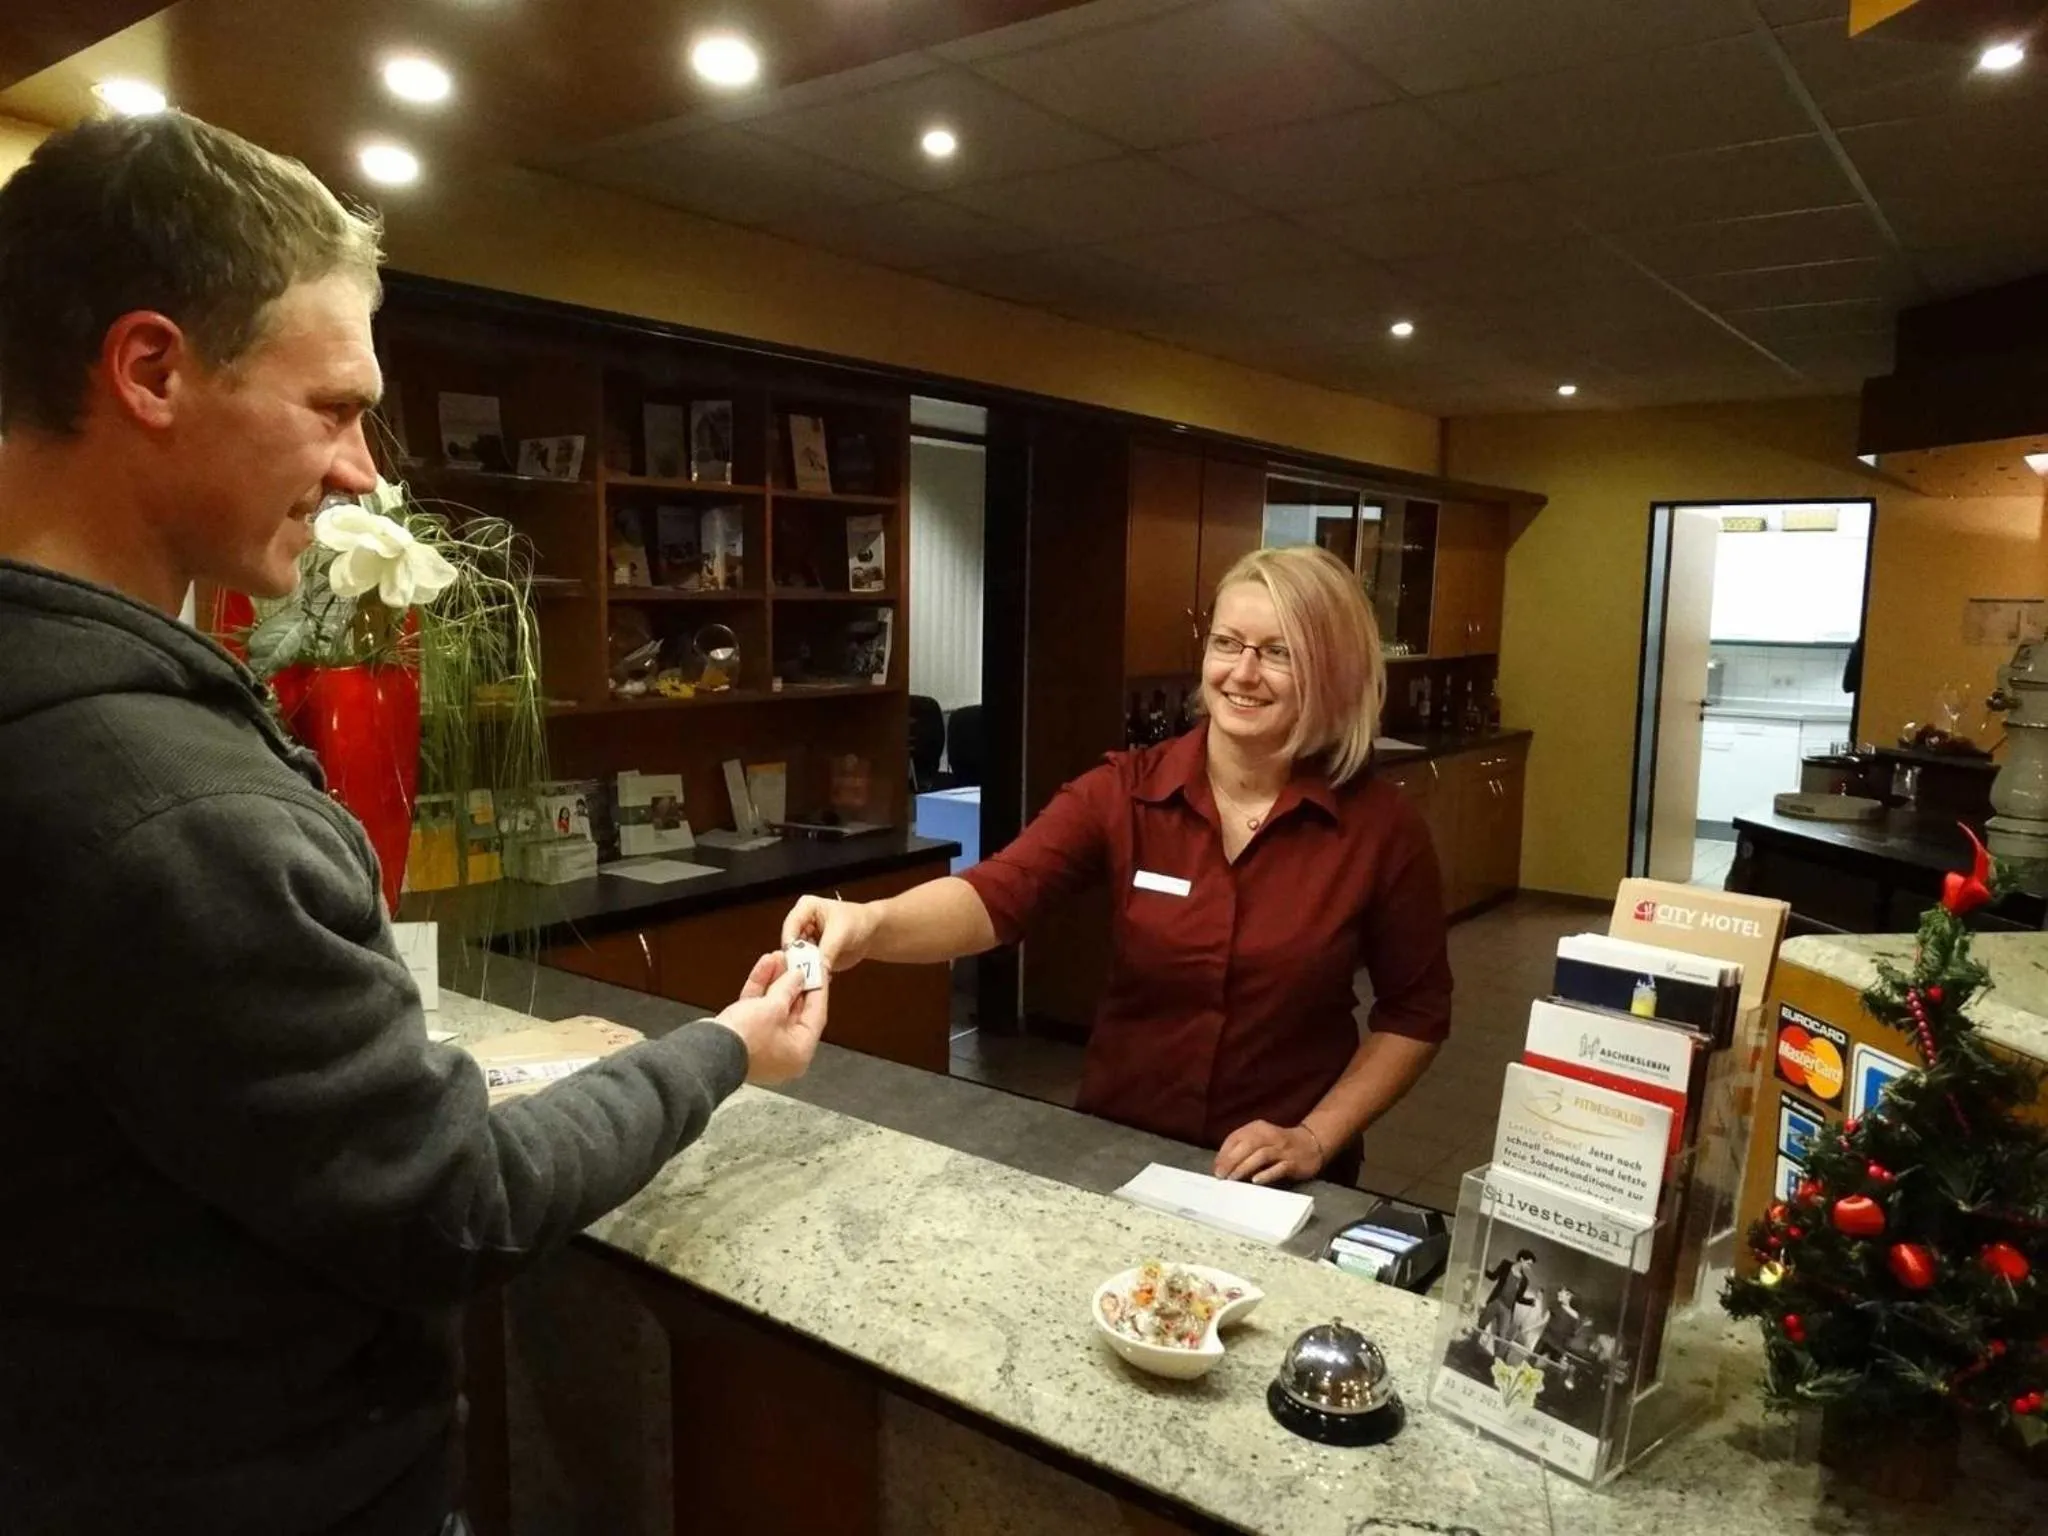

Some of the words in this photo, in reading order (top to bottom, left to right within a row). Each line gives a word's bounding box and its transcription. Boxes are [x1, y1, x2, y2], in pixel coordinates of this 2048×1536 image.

[1657, 904, 1697, 925] CITY
[1701, 911, 1763, 938] HOTEL
[1781, 1006, 1846, 1045] EUROCARD
[1600, 1048, 1671, 1073] ASCHERSLEBEN
[1779, 1041, 1840, 1082] MasterCard
[1504, 1147, 1527, 1161] freie
[1530, 1155, 1624, 1194] Sonderkonditionen
[1627, 1191, 1645, 1201] zur
[1506, 1135, 1541, 1151] schnell
[1543, 1148, 1592, 1169] anmelden
[1595, 1163, 1615, 1176] und
[1617, 1167, 1647, 1187] letzte
[1588, 1147, 1614, 1161] Jetzt
[1616, 1157, 1642, 1171] noch
